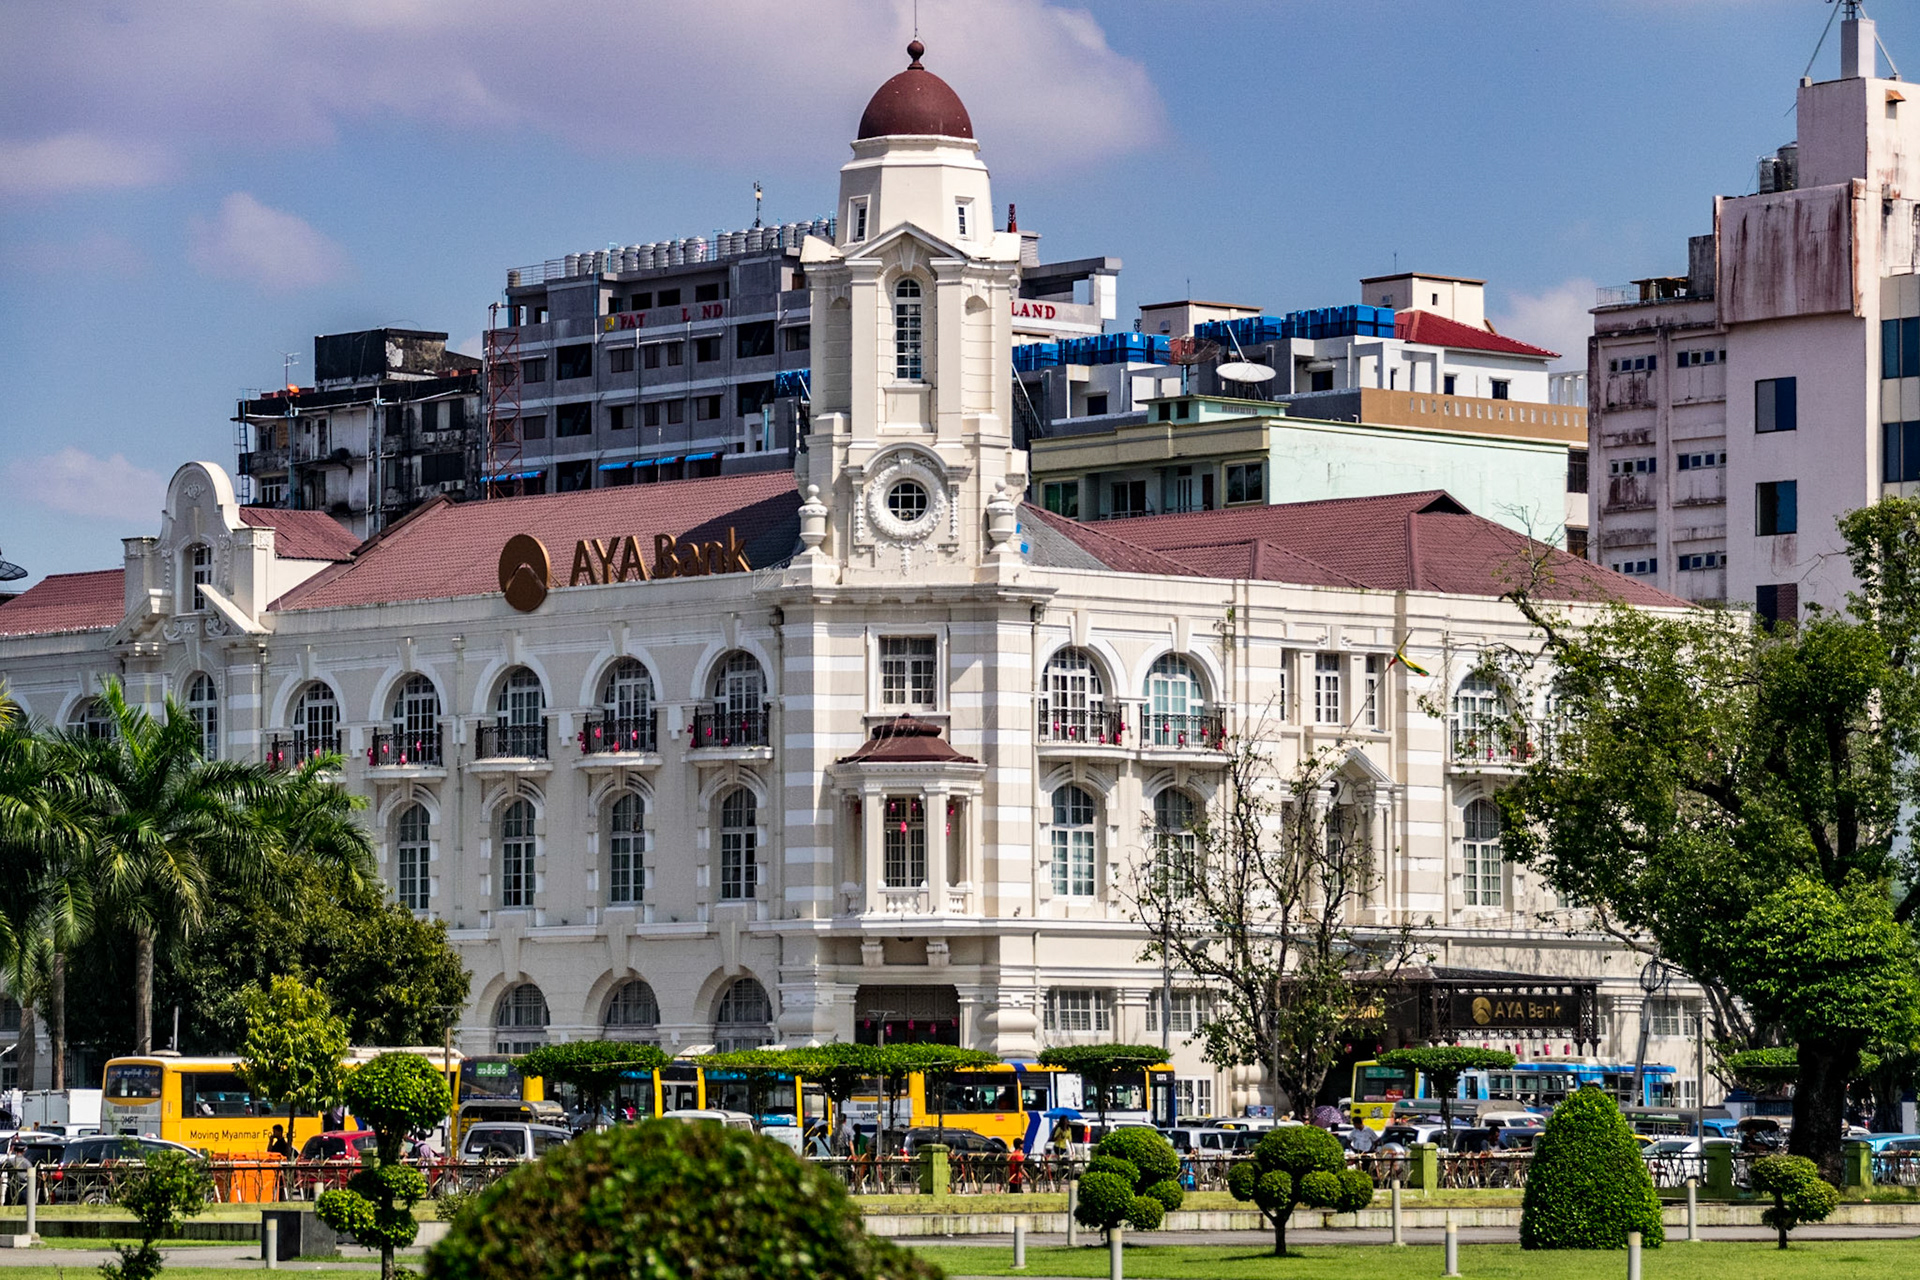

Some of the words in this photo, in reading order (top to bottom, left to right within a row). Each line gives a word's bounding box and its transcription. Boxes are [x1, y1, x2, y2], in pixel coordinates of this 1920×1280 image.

[570, 535, 649, 586] AYA
[654, 527, 751, 580] Bank
[1494, 1001, 1525, 1018] AYA
[1528, 1000, 1561, 1018] Bank
[190, 1130, 219, 1142] Moving
[222, 1129, 260, 1141] Myanmar
